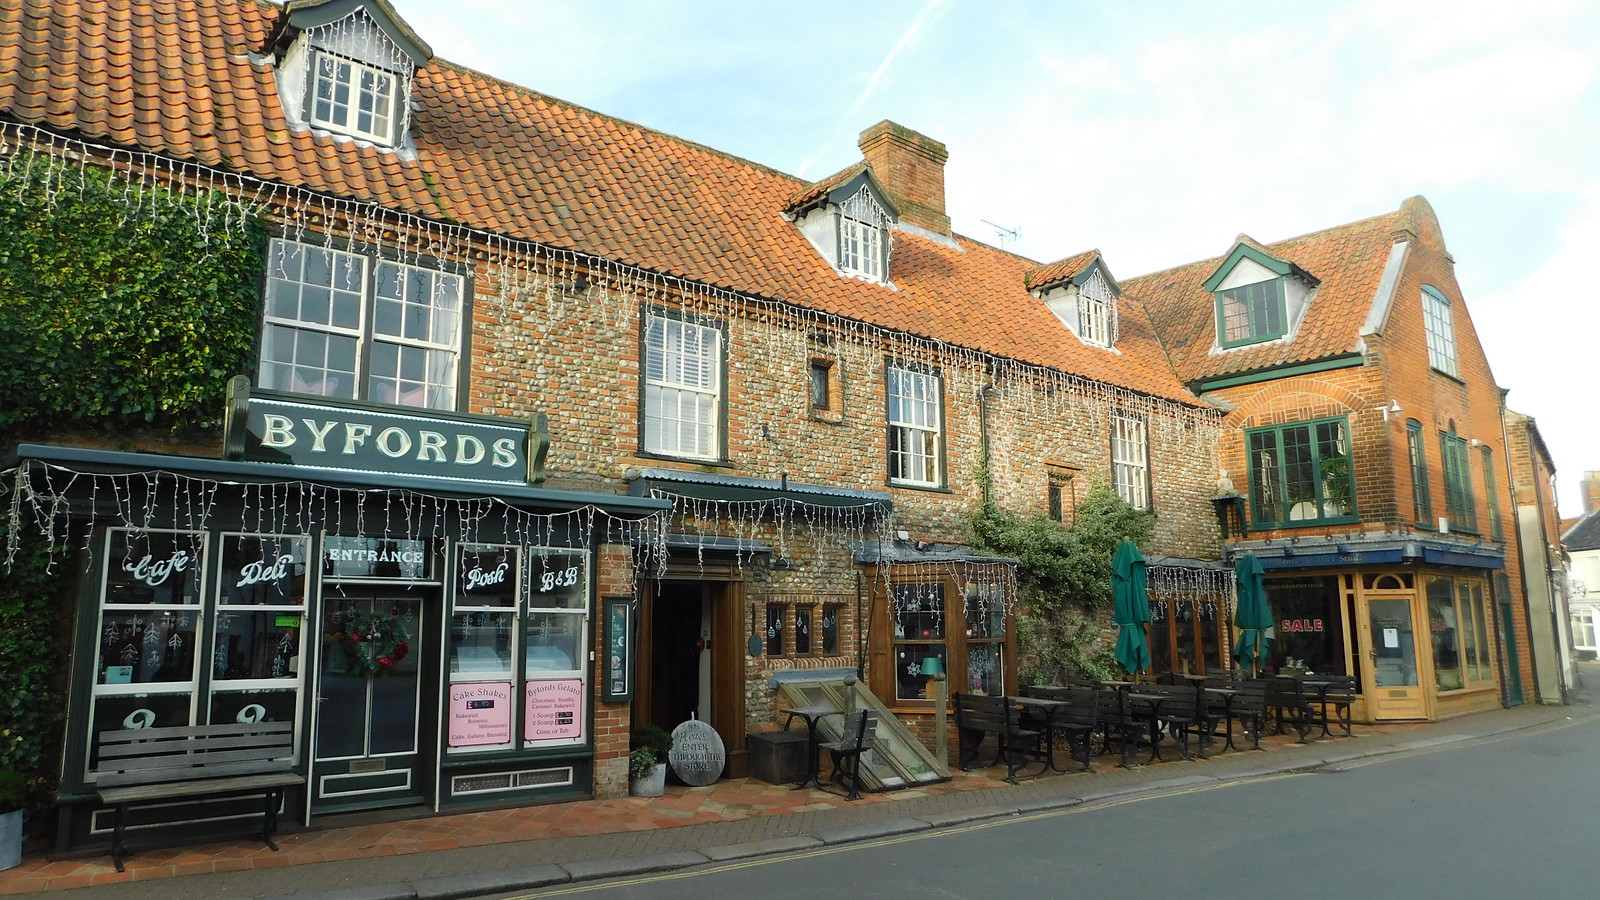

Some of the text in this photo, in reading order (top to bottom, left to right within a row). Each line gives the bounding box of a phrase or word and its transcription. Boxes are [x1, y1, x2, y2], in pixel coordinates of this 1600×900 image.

[260, 413, 518, 468] BYFORDS
[329, 548, 423, 563] ENTRANCE
[125, 551, 189, 586] Cafe
[236, 554, 294, 587] Deli
[466, 563, 509, 590] Posh
[1282, 619, 1323, 632] SALE
[453, 688, 507, 702] Cake Shakes
[527, 683, 580, 697] Byfords Gelato
[682, 743, 709, 751] ENTER
[673, 753, 723, 761] THROUGH THE
[684, 762, 711, 771] STORE
